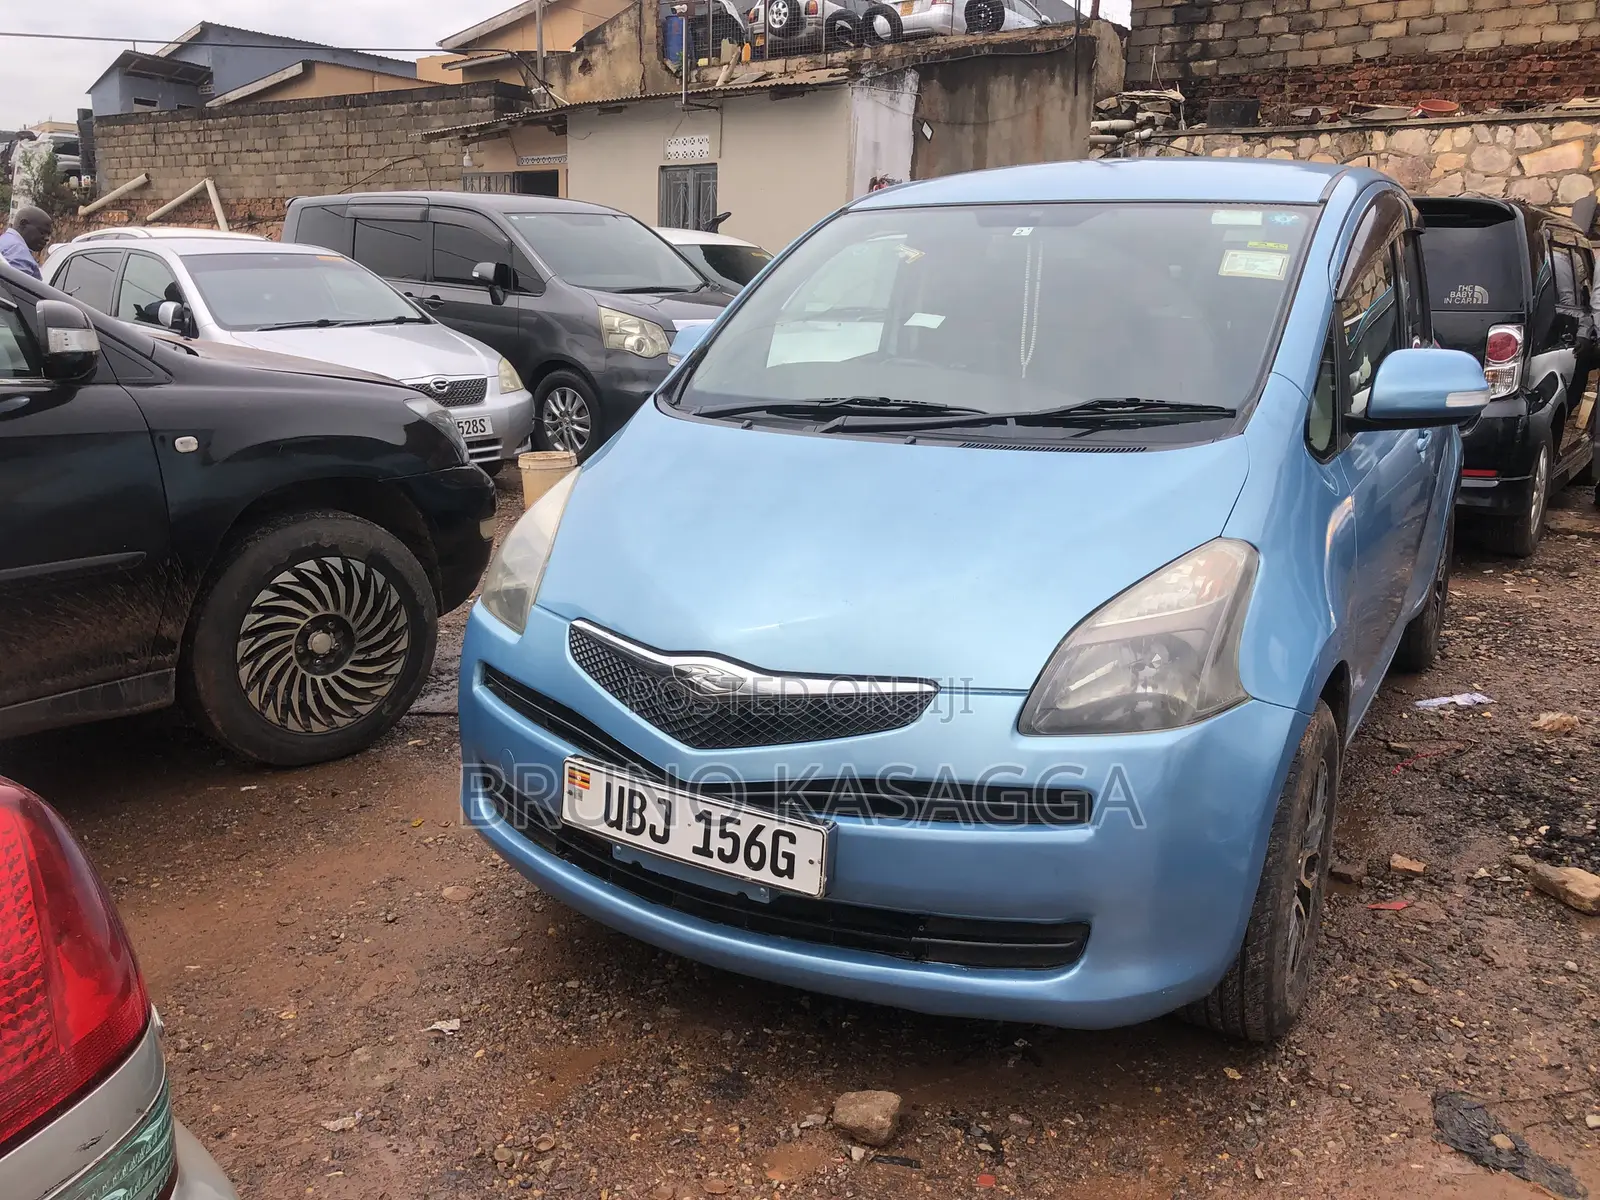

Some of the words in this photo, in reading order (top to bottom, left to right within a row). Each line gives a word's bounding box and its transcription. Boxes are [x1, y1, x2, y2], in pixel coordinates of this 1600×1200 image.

[456, 418, 486, 435] 528S
[603, 781, 672, 845] UBJ
[691, 809, 797, 880] 156G
